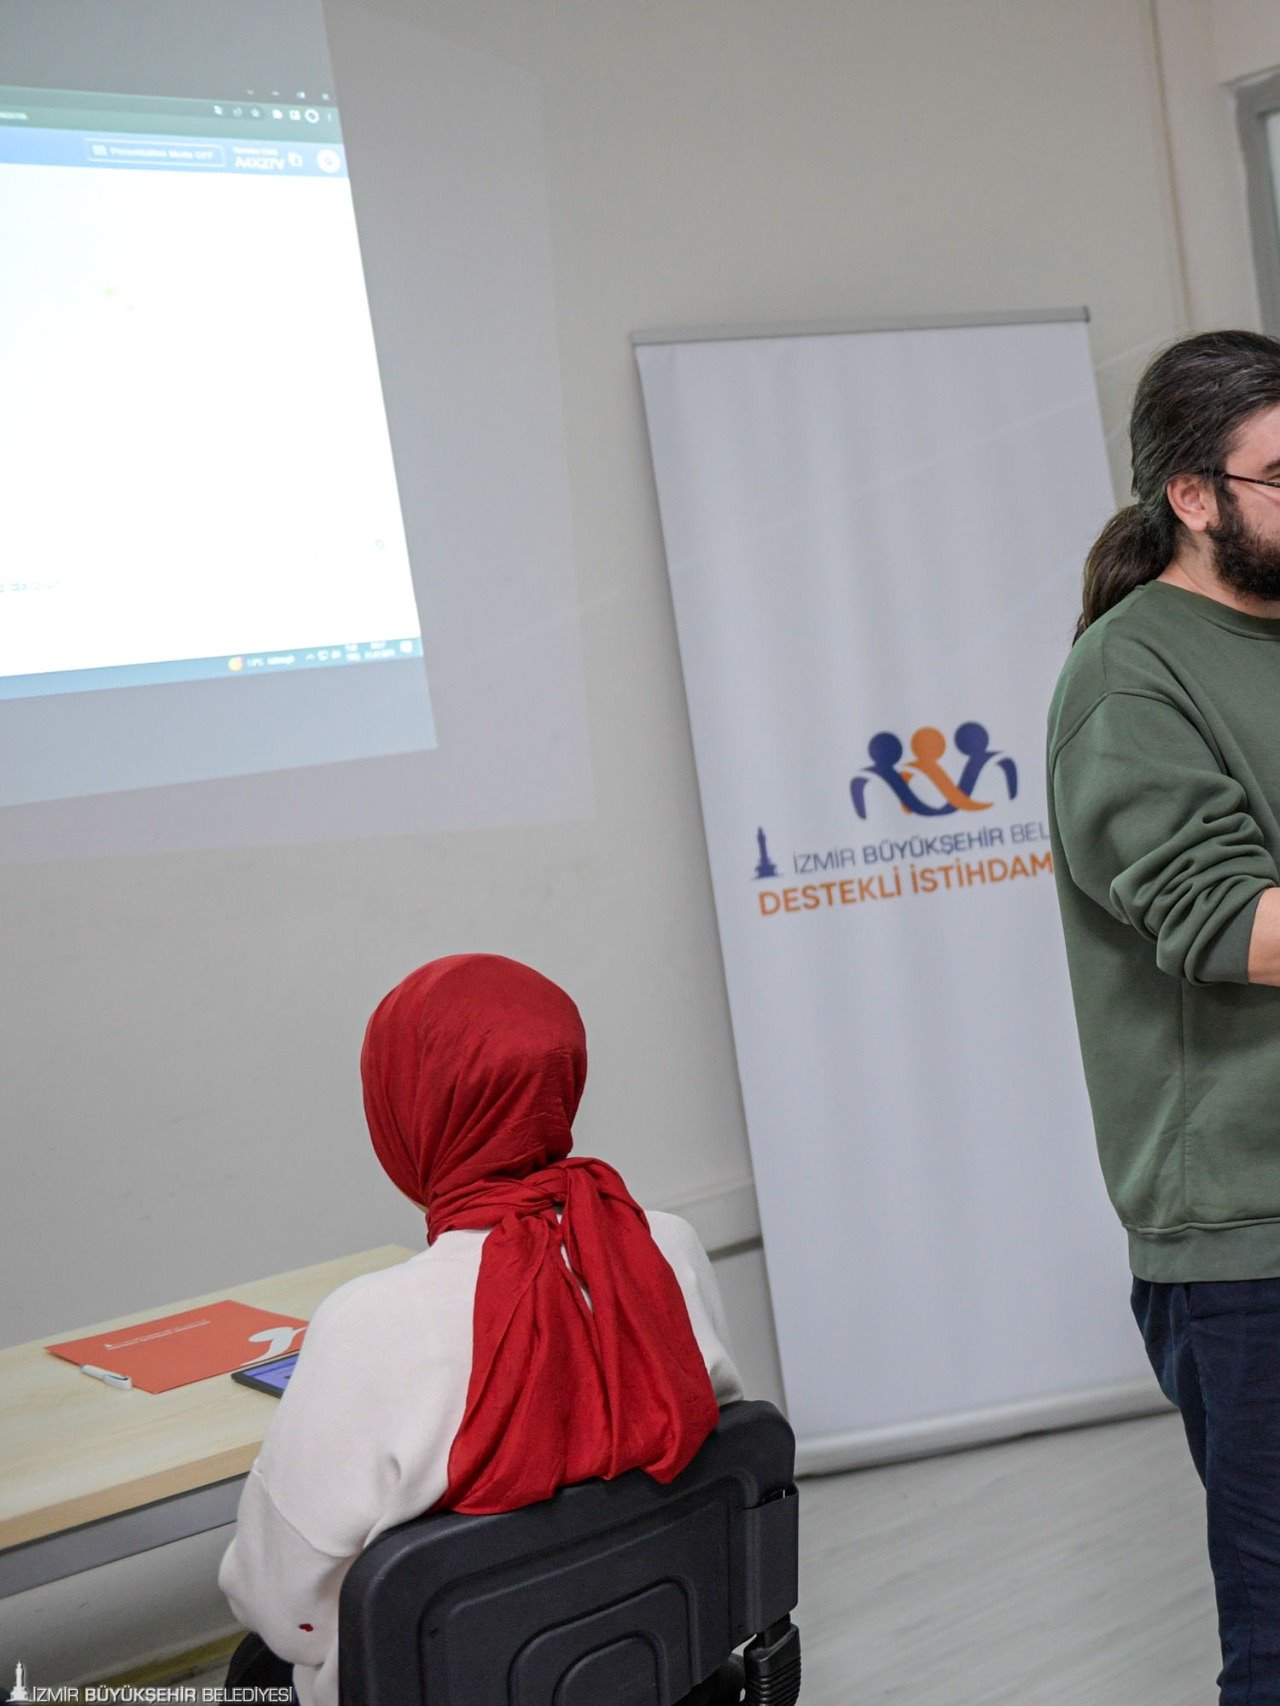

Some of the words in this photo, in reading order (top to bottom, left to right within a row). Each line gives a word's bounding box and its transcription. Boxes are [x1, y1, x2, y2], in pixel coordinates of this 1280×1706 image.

[793, 848, 856, 875] İZMİR
[862, 825, 1004, 865] BÜYÜKŞEHİR
[1011, 821, 1050, 844] BEL
[758, 867, 902, 917] DESTEKLİ
[911, 850, 1054, 895] İSTİHDAM
